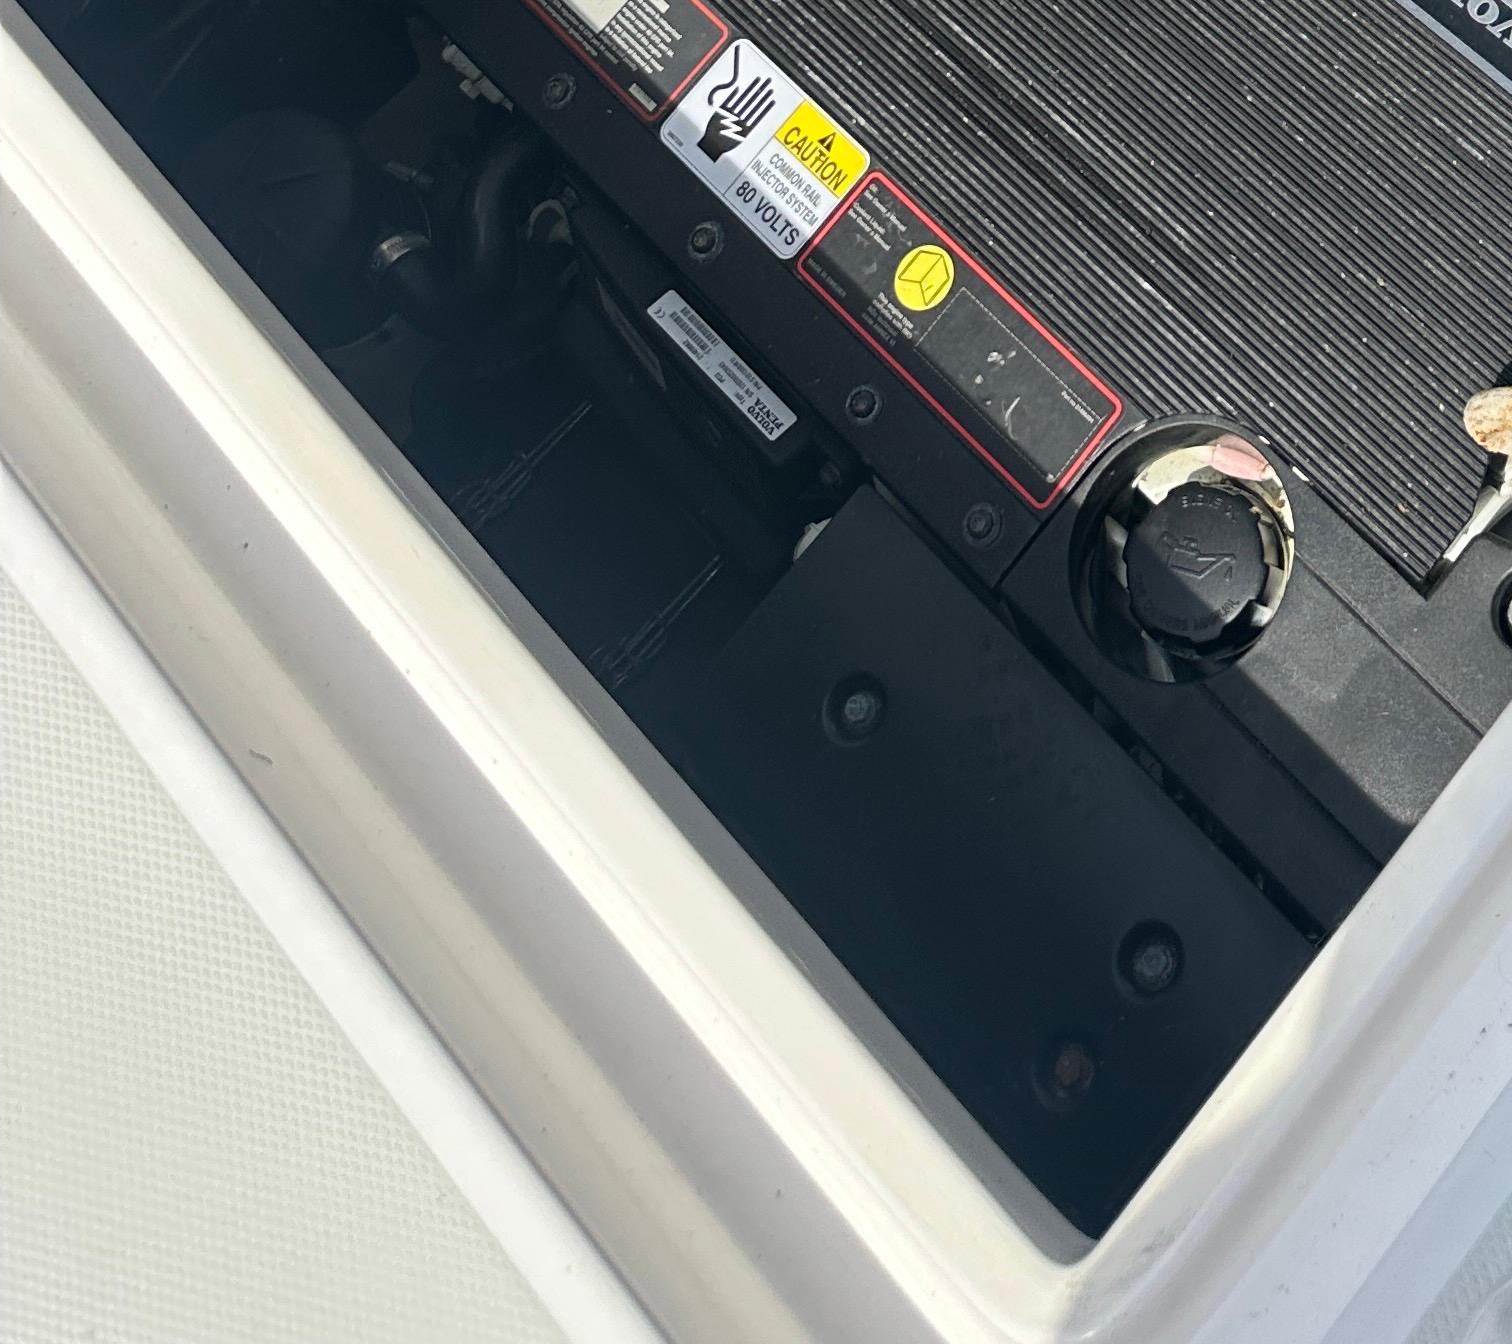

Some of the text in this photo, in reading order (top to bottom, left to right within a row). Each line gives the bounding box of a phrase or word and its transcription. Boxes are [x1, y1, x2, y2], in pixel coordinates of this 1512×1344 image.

[769, 152, 821, 207] COMMON RAIL
[783, 126, 847, 190] CAUTION
[735, 180, 799, 245] 80 VOLTS
[750, 159, 818, 226] INJECTOR SYSTEM
[746, 405, 774, 435] VOLVO
[753, 397, 784, 430] PENTA
